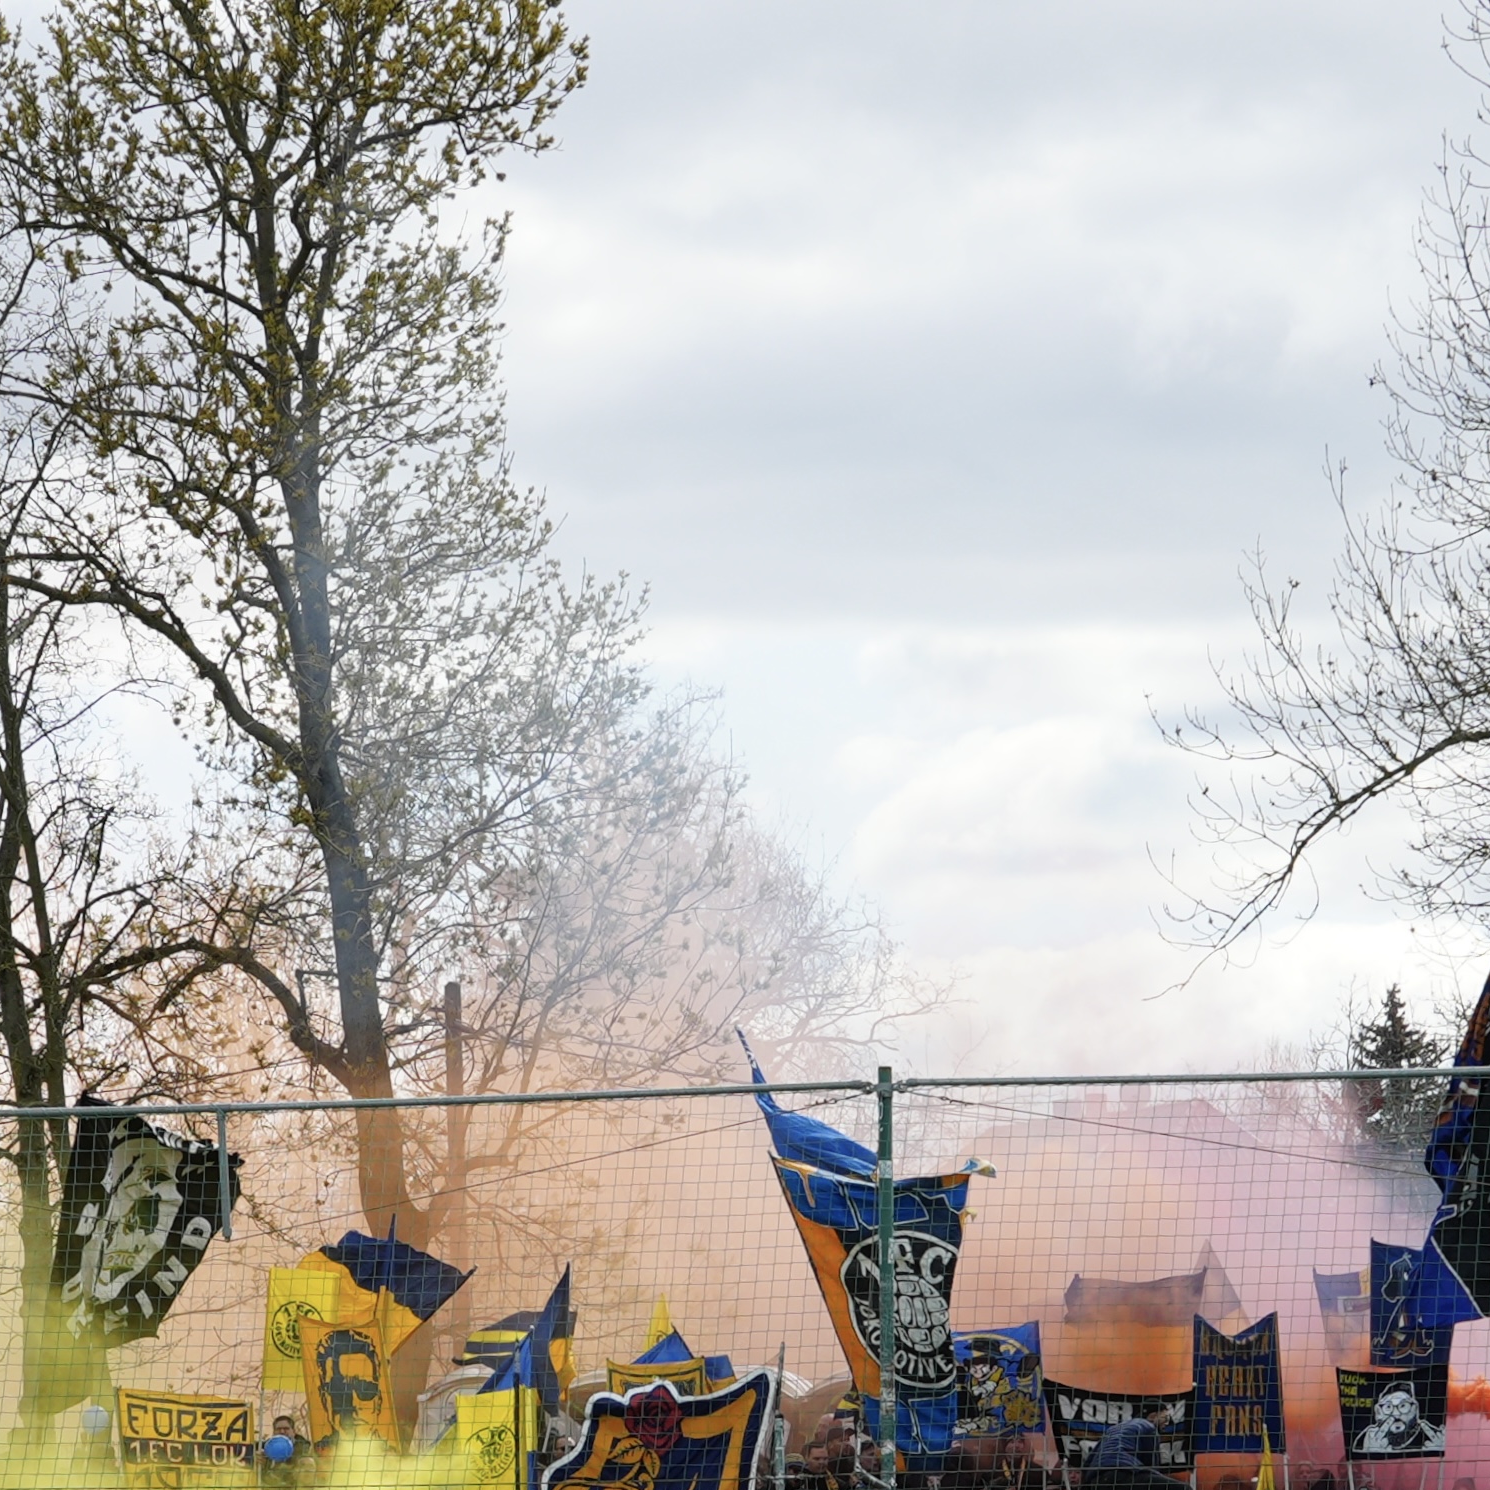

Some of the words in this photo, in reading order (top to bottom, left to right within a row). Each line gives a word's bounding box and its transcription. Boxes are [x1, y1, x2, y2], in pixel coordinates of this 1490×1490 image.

[853, 1296, 953, 1379] LOKOOTIVE
[127, 1403, 249, 1442] FORZA
[193, 1445, 246, 1467] LOK
